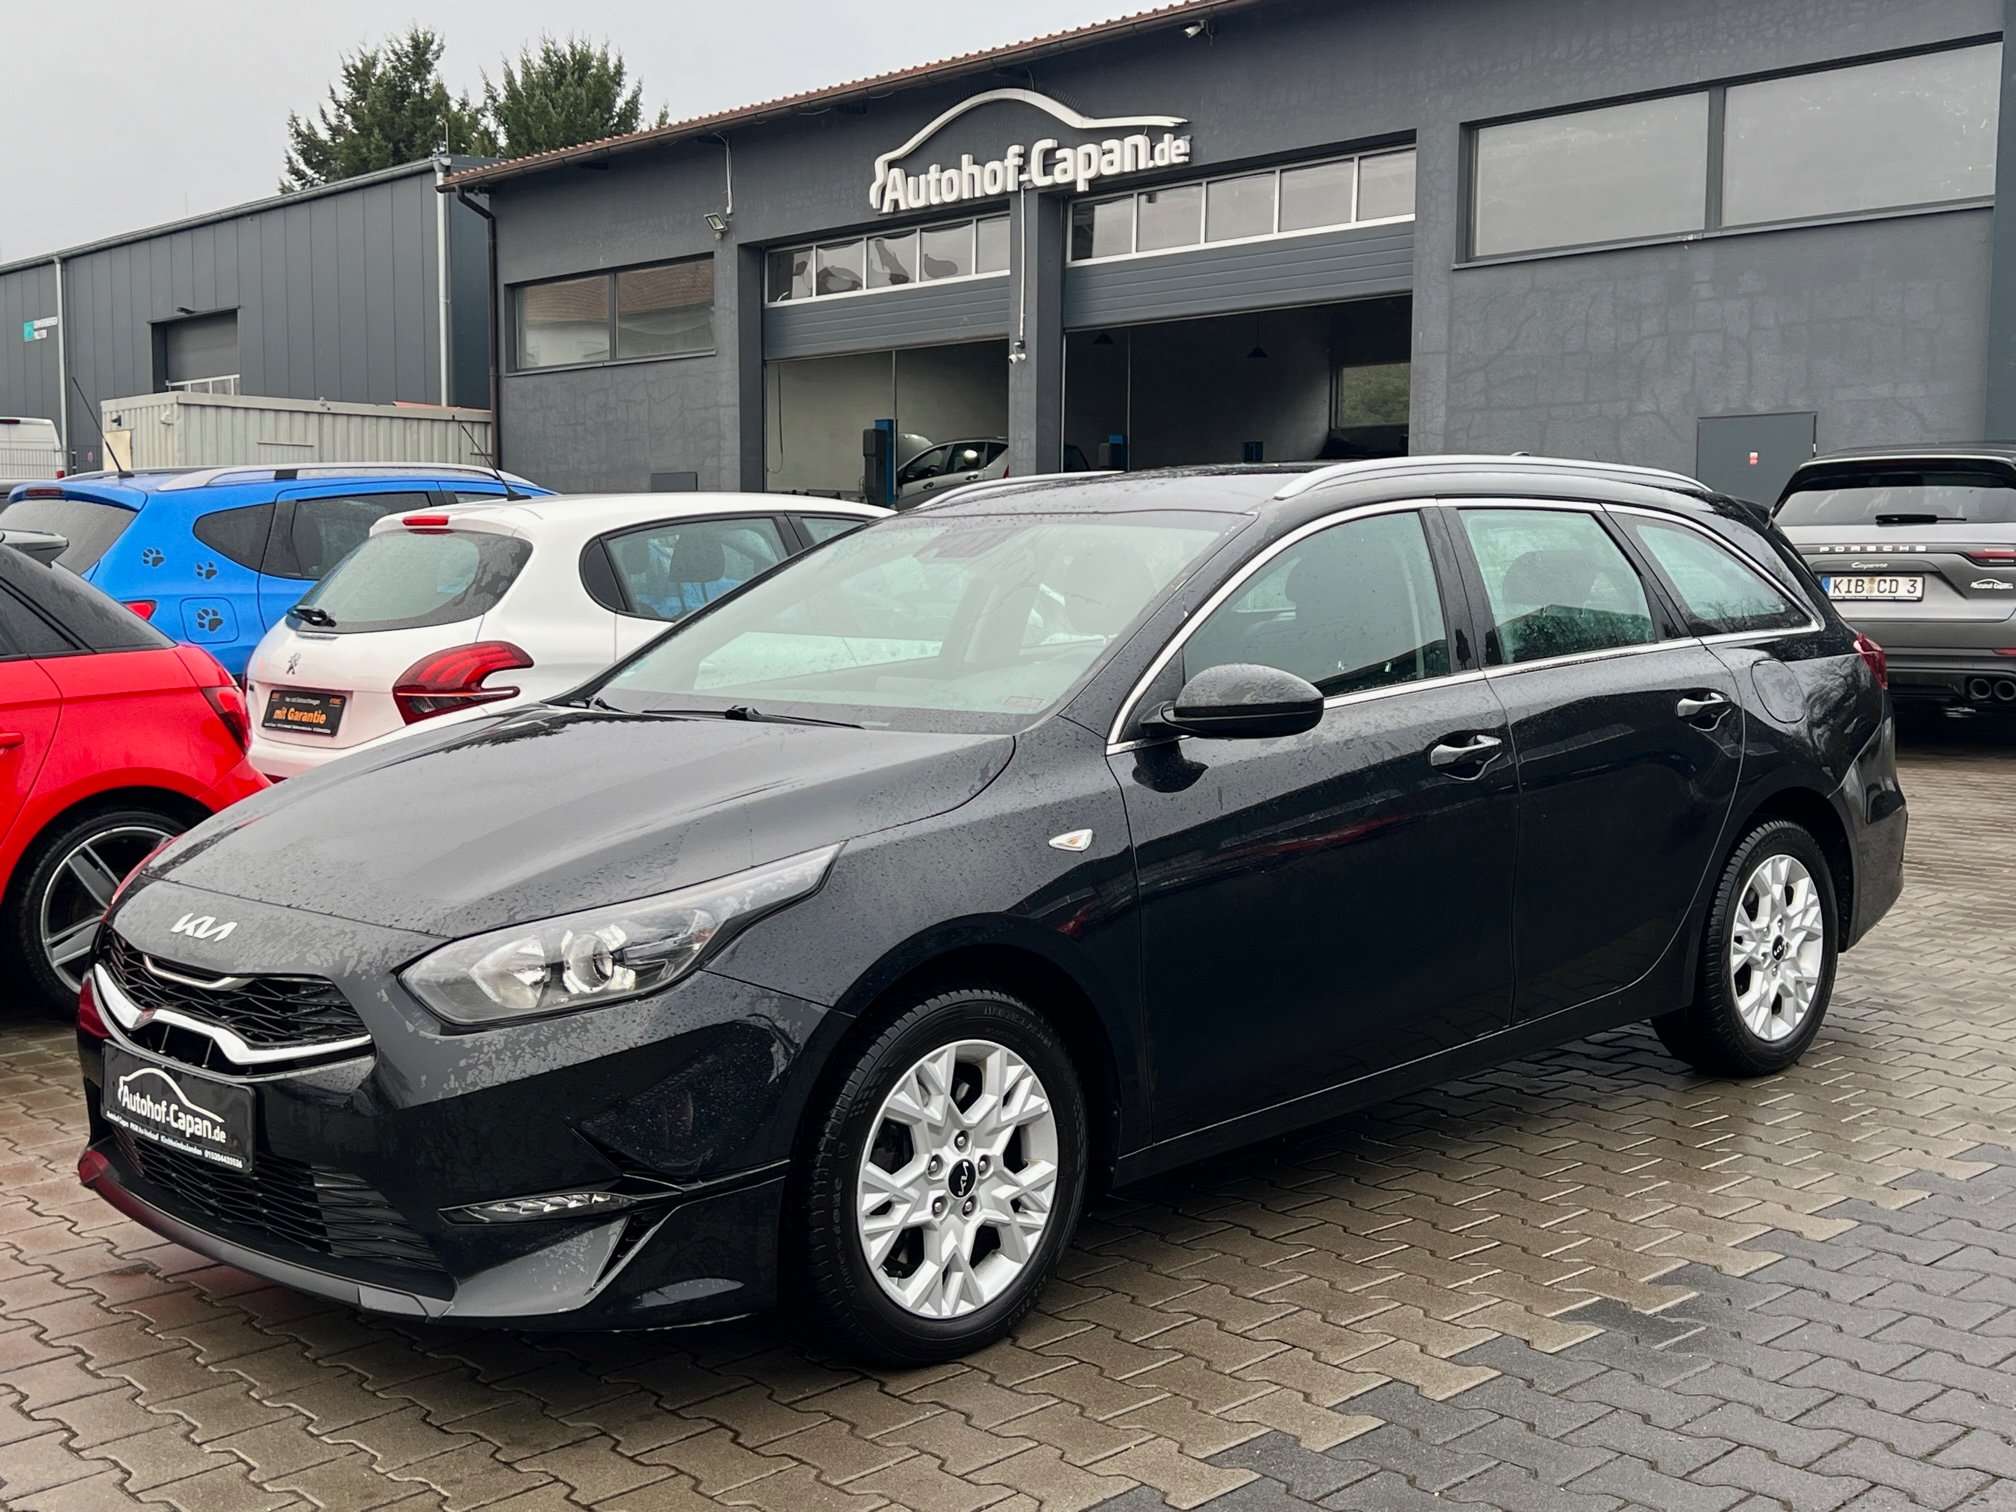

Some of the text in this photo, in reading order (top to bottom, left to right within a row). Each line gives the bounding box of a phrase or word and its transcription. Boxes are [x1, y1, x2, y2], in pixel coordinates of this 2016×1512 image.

[881, 133, 1191, 213] Autohof-Capan.de
[1820, 545, 1927, 553] PORSCHE
[1833, 578, 1918, 594] KIB CD 3
[287, 707, 327, 725] Garantie
[122, 1085, 227, 1143] Autohof-Capan.de
